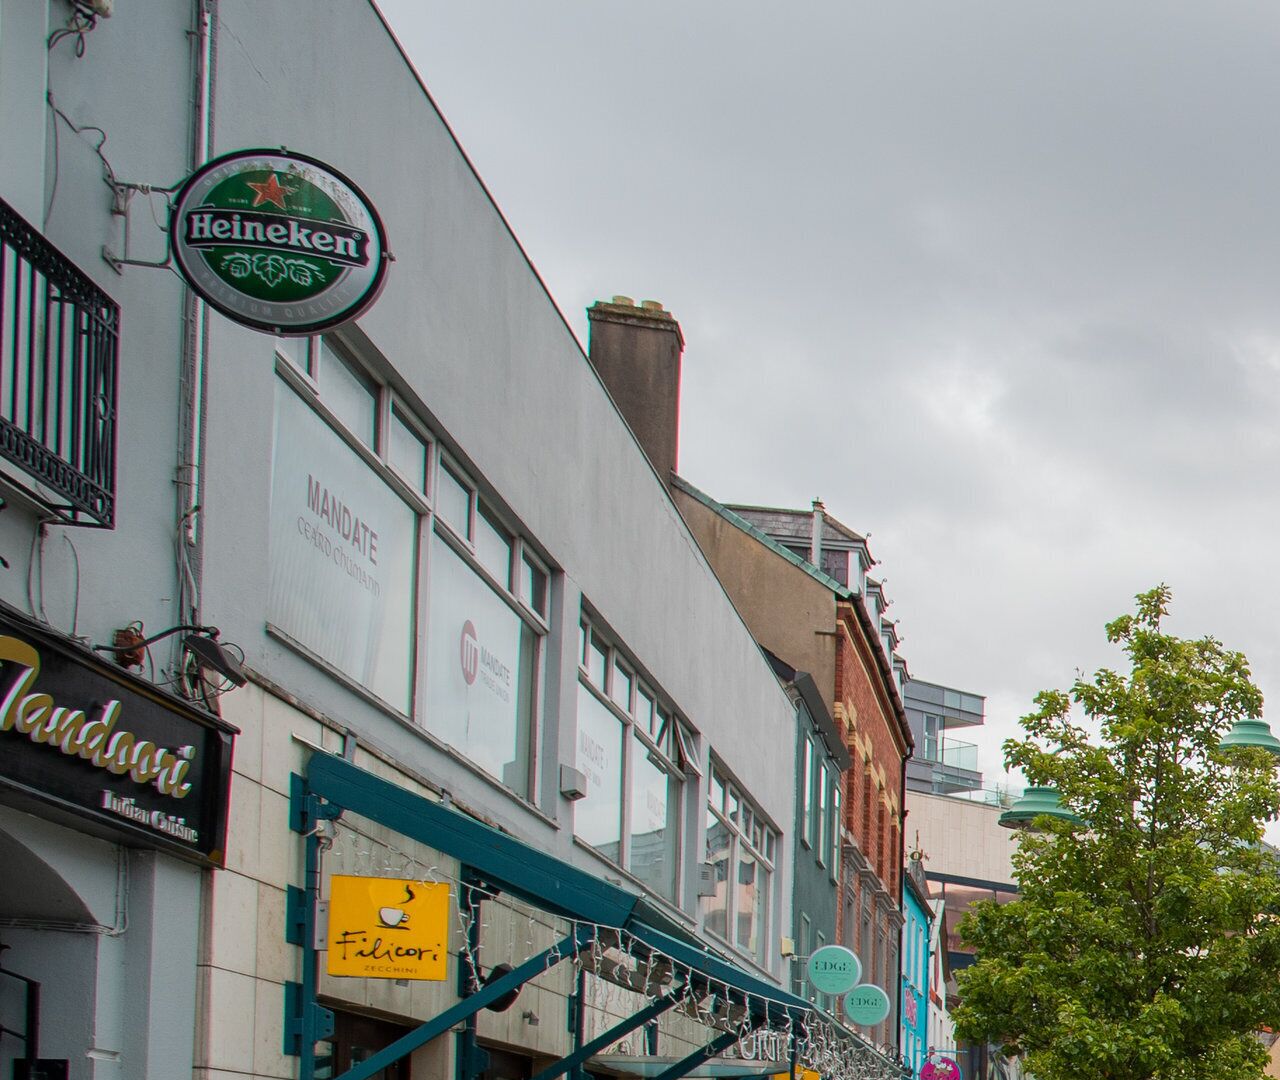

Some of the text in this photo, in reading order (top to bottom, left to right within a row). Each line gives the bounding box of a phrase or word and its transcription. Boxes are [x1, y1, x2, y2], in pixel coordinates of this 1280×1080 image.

[190, 213, 360, 258] Heineken
[306, 473, 379, 567] MANDATE
[335, 930, 441, 963] Filicori
[363, 964, 418, 975] ZECCHINI
[814, 960, 852, 972] EDGE
[850, 996, 883, 1007] EDGE
